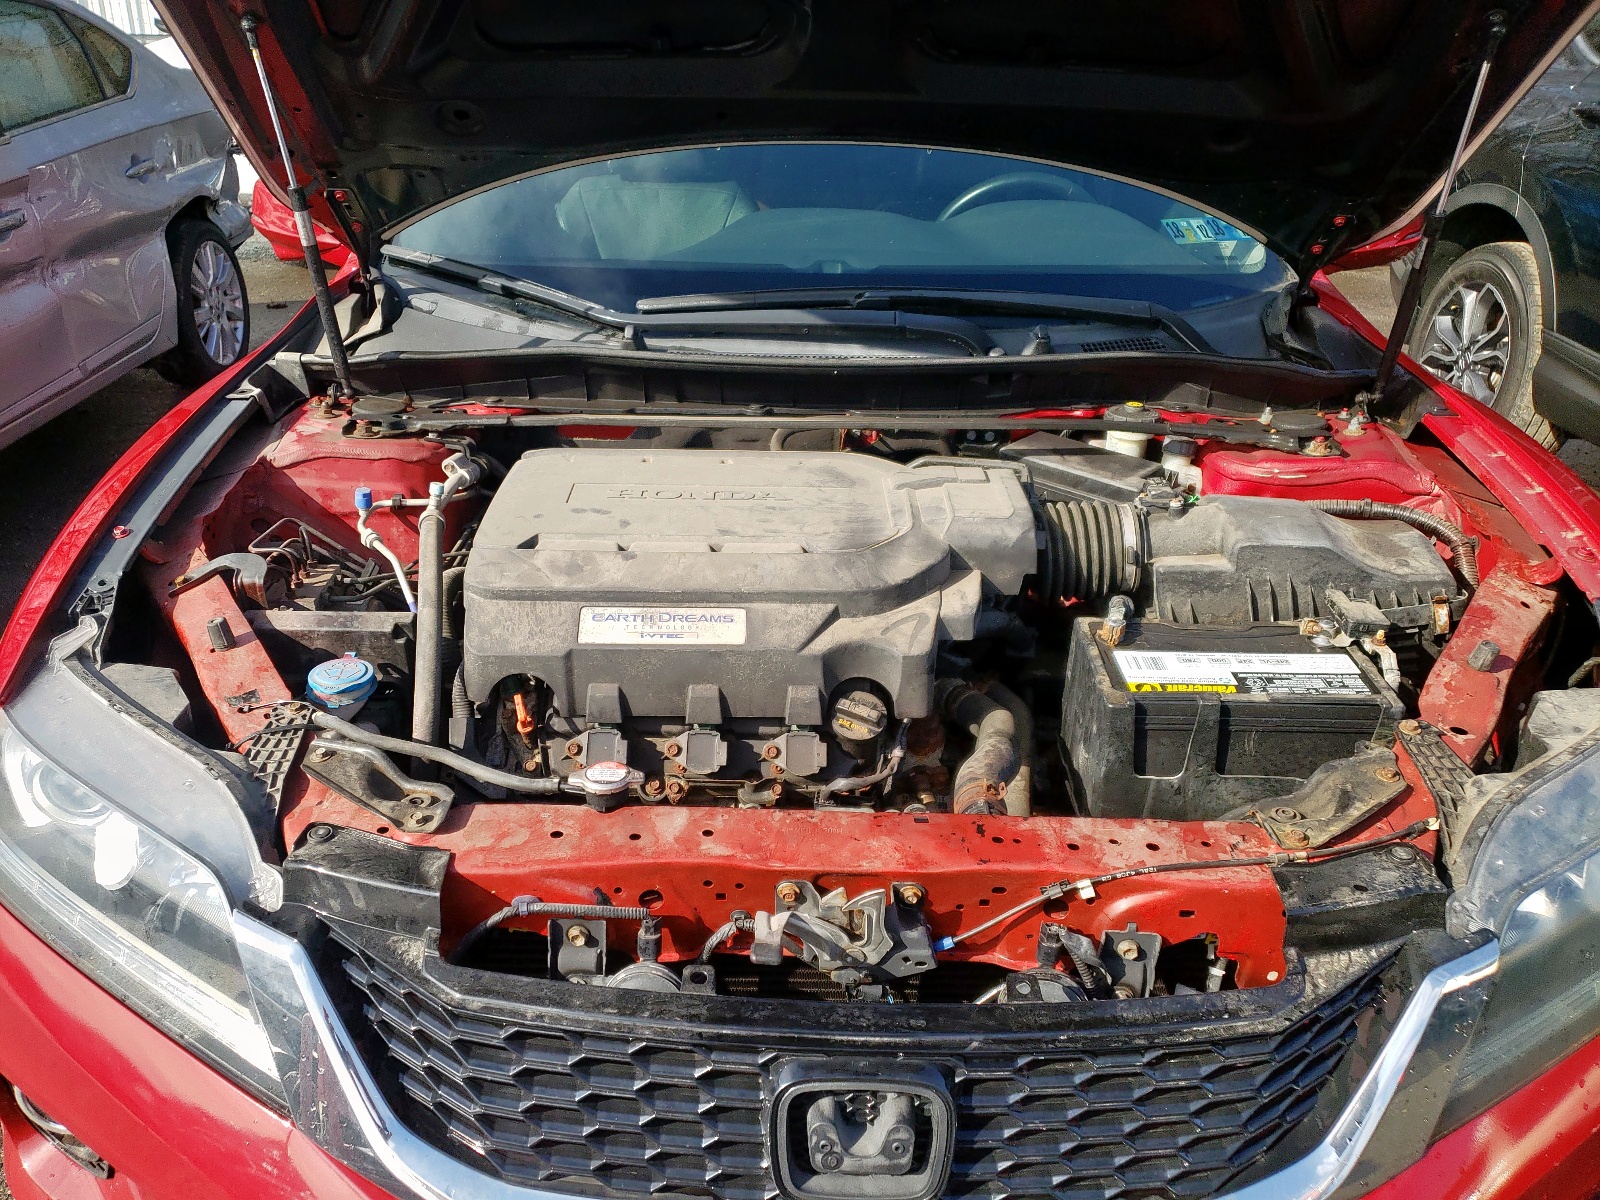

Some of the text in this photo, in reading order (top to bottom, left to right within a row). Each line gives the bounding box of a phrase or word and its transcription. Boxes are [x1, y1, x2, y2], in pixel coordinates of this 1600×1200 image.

[1166, 222, 1185, 238] 18
[1196, 224, 1212, 238] 12
[1207, 219, 1226, 236] 18
[607, 489, 794, 501] HONDA
[591, 612, 654, 623] EARTH
